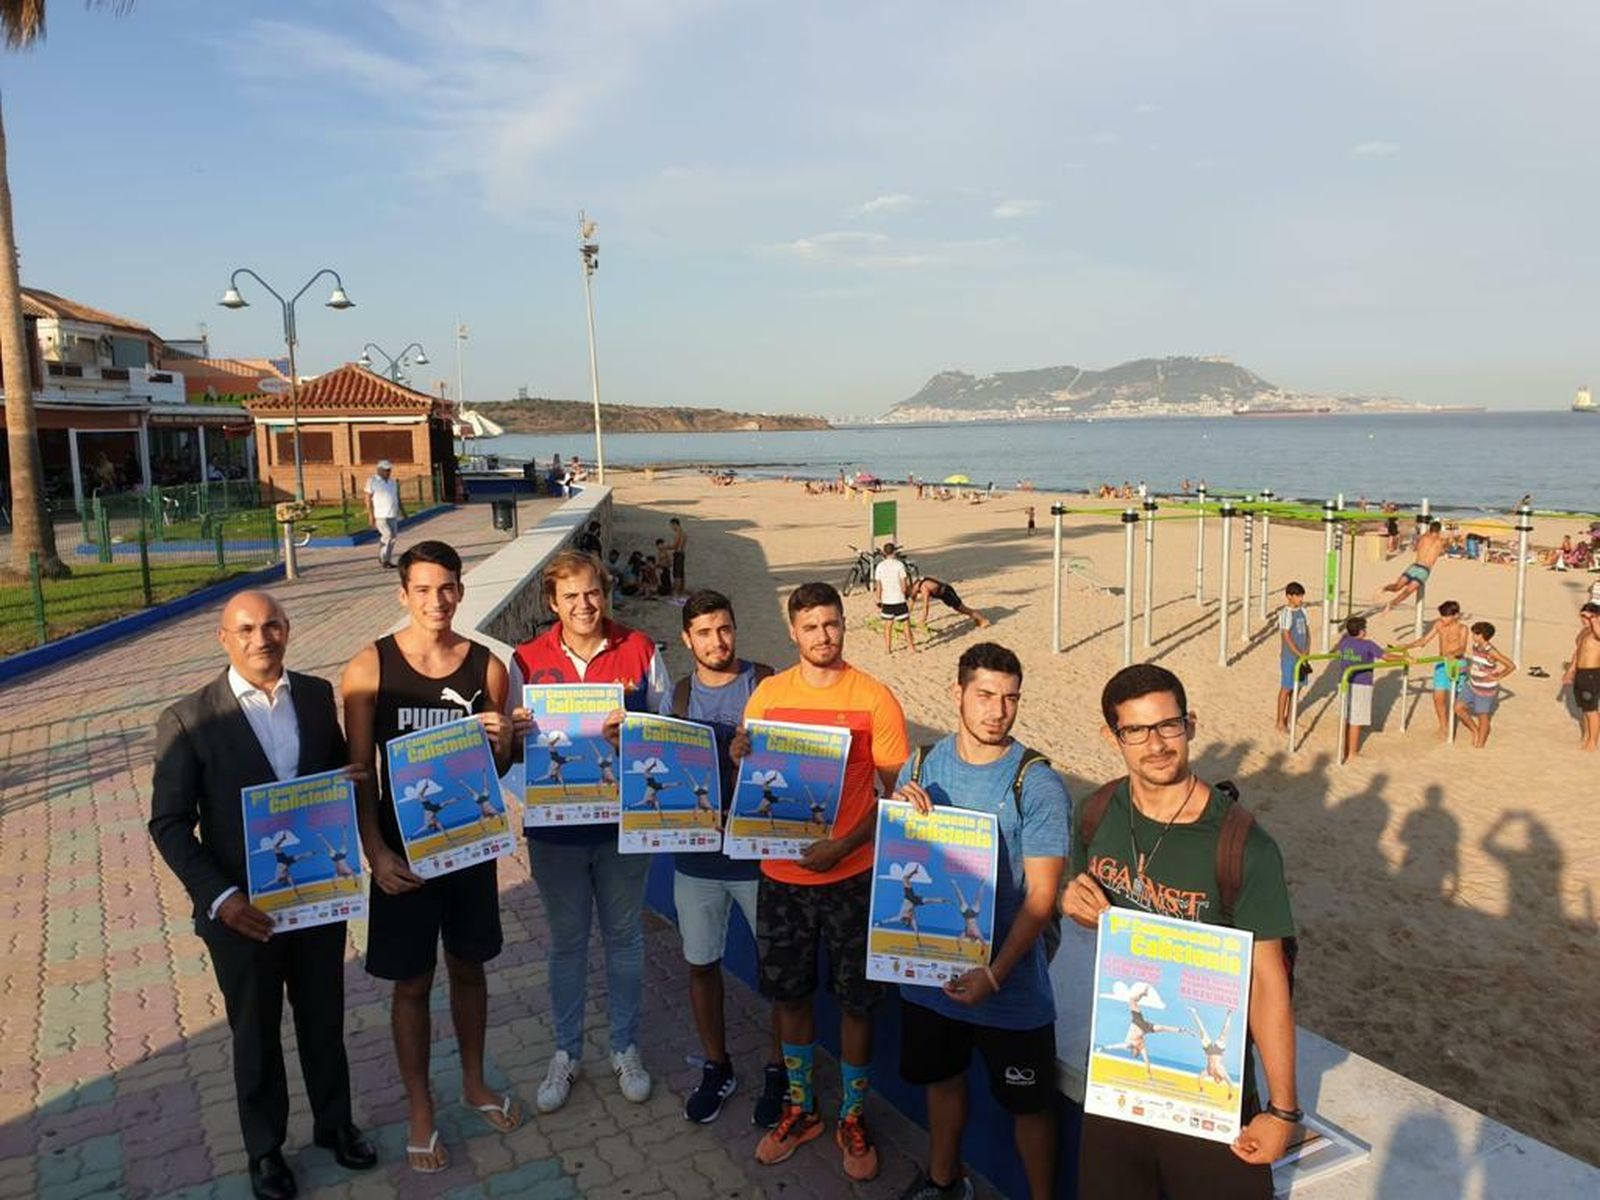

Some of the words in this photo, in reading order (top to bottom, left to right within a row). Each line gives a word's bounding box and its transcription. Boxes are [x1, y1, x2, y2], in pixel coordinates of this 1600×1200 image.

[407, 733, 484, 763] Calistenia
[642, 724, 711, 749] Calistenia
[904, 820, 992, 848] Calistenia
[1131, 933, 1241, 976] Calistenia
